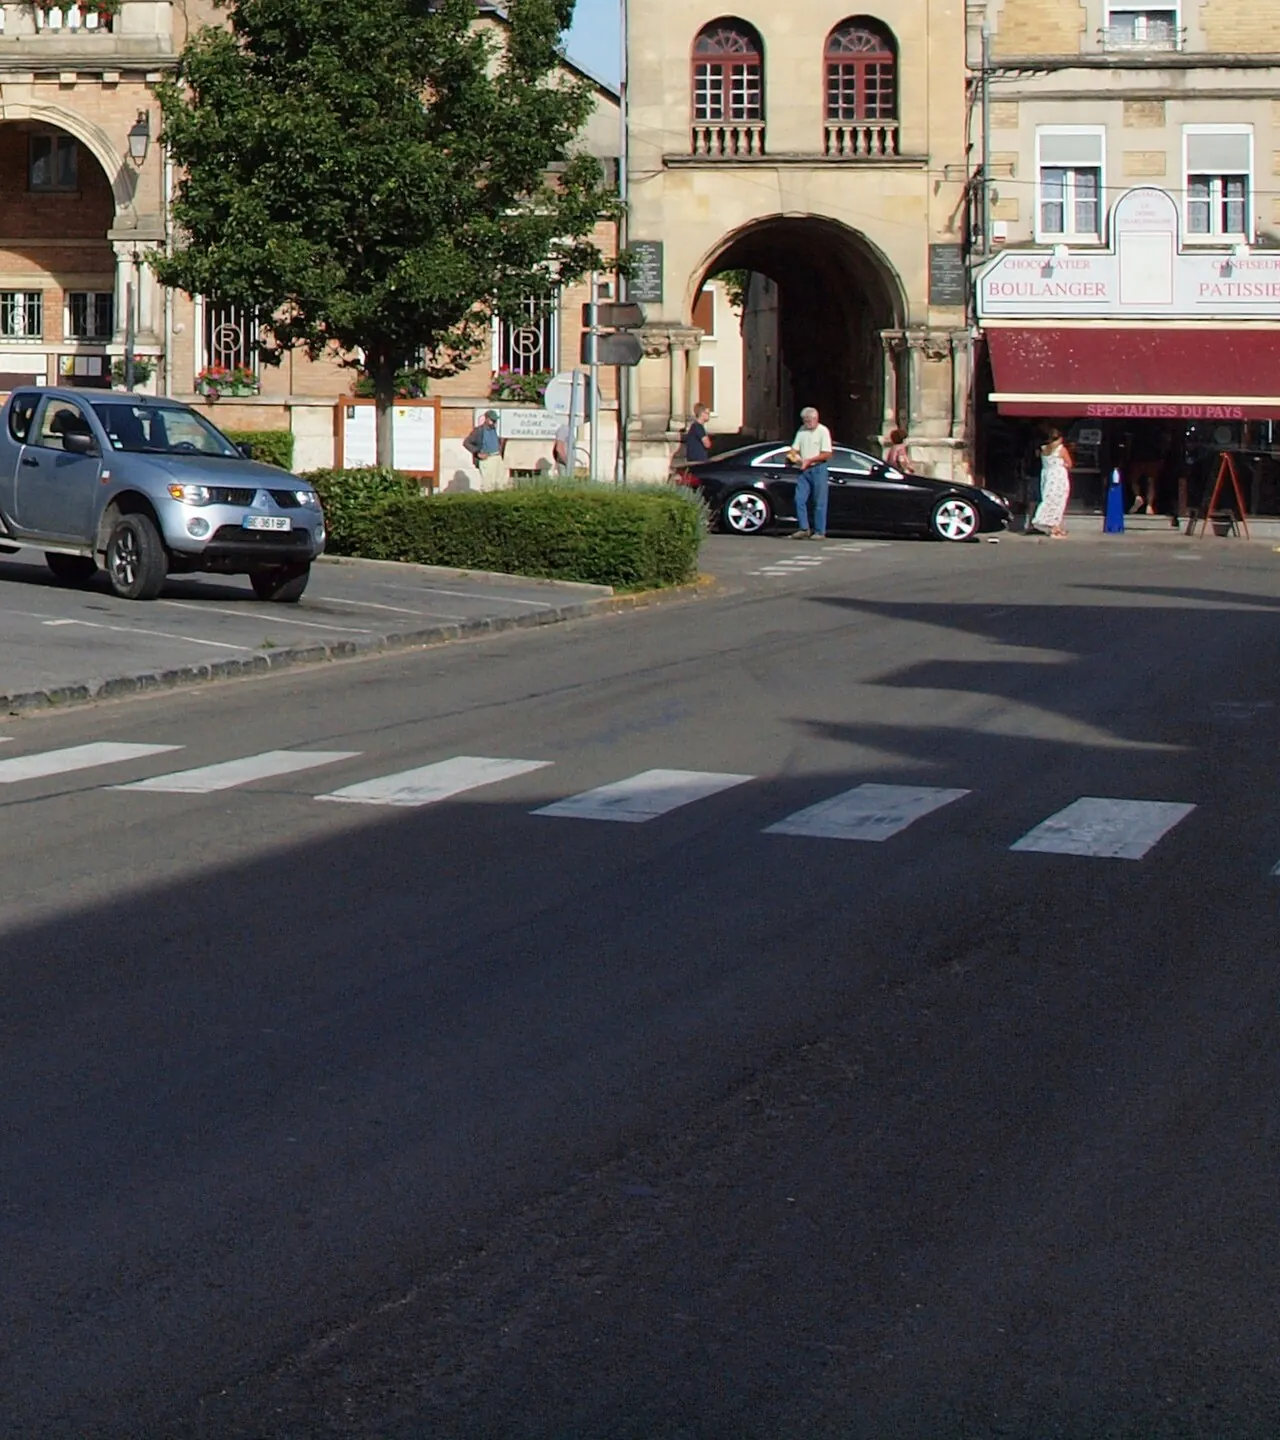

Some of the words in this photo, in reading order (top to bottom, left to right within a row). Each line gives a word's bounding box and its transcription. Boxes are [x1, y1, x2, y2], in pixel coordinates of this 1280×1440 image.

[1003, 259, 1091, 269] CHOCOATIER
[1212, 259, 1280, 270] CNFISEUR
[988, 282, 1107, 297] BOULANGER
[1086, 404, 1177, 418] SPECIALITES
[1181, 405, 1201, 418] DU
[1206, 406, 1243, 418] PAYS
